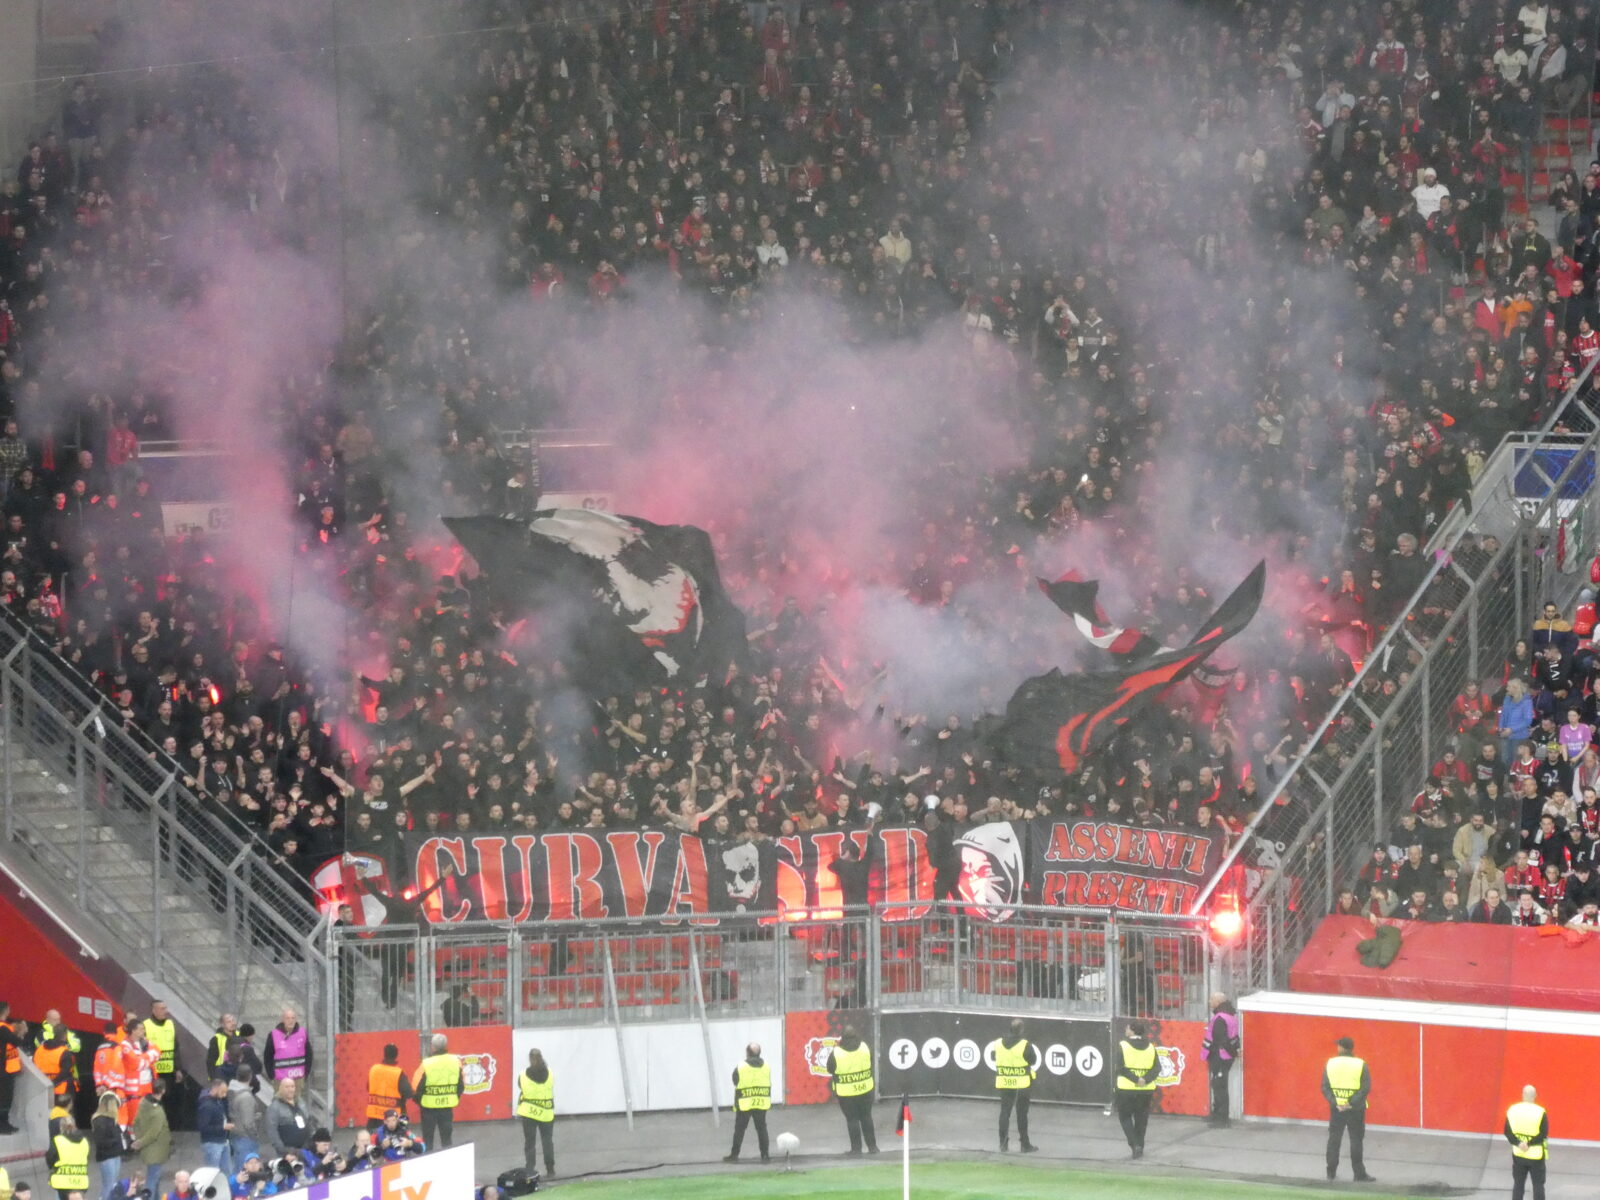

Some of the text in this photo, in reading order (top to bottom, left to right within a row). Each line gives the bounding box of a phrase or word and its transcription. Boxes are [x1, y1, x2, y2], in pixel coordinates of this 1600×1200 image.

[1044, 822, 1211, 875] ASSENTI
[416, 832, 719, 926] CURVA
[1042, 871, 1199, 916] PRESENTI
[998, 1067, 1025, 1076] EWARD
